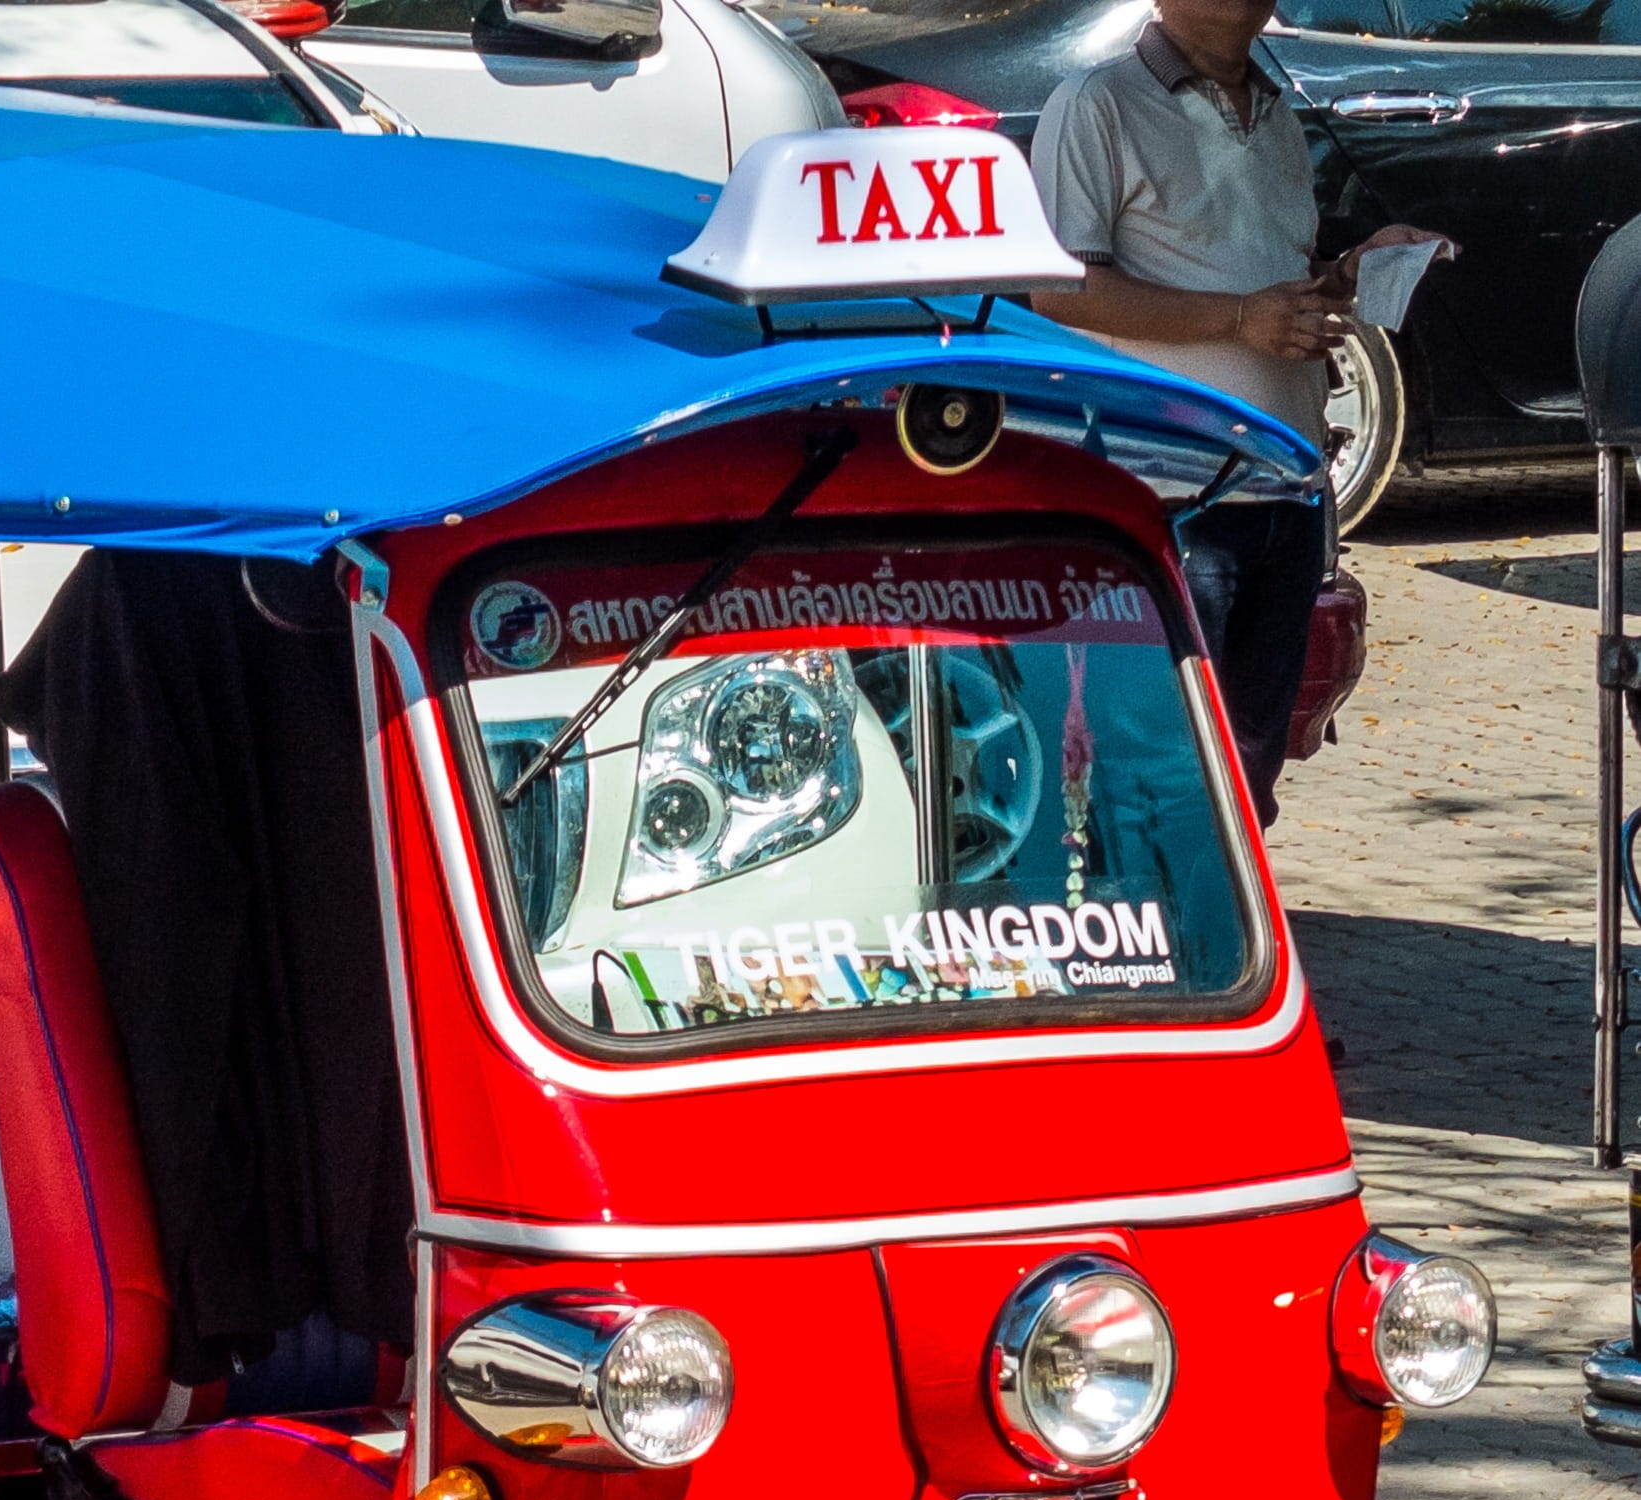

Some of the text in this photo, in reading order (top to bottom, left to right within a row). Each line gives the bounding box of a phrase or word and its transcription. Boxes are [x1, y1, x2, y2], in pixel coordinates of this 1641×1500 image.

[799, 155, 1005, 244] TAXI
[1059, 564, 1143, 623] จำกัด
[665, 900, 1170, 986] TIGER KINGDOM
[1066, 958, 1176, 989] Chiangmai
